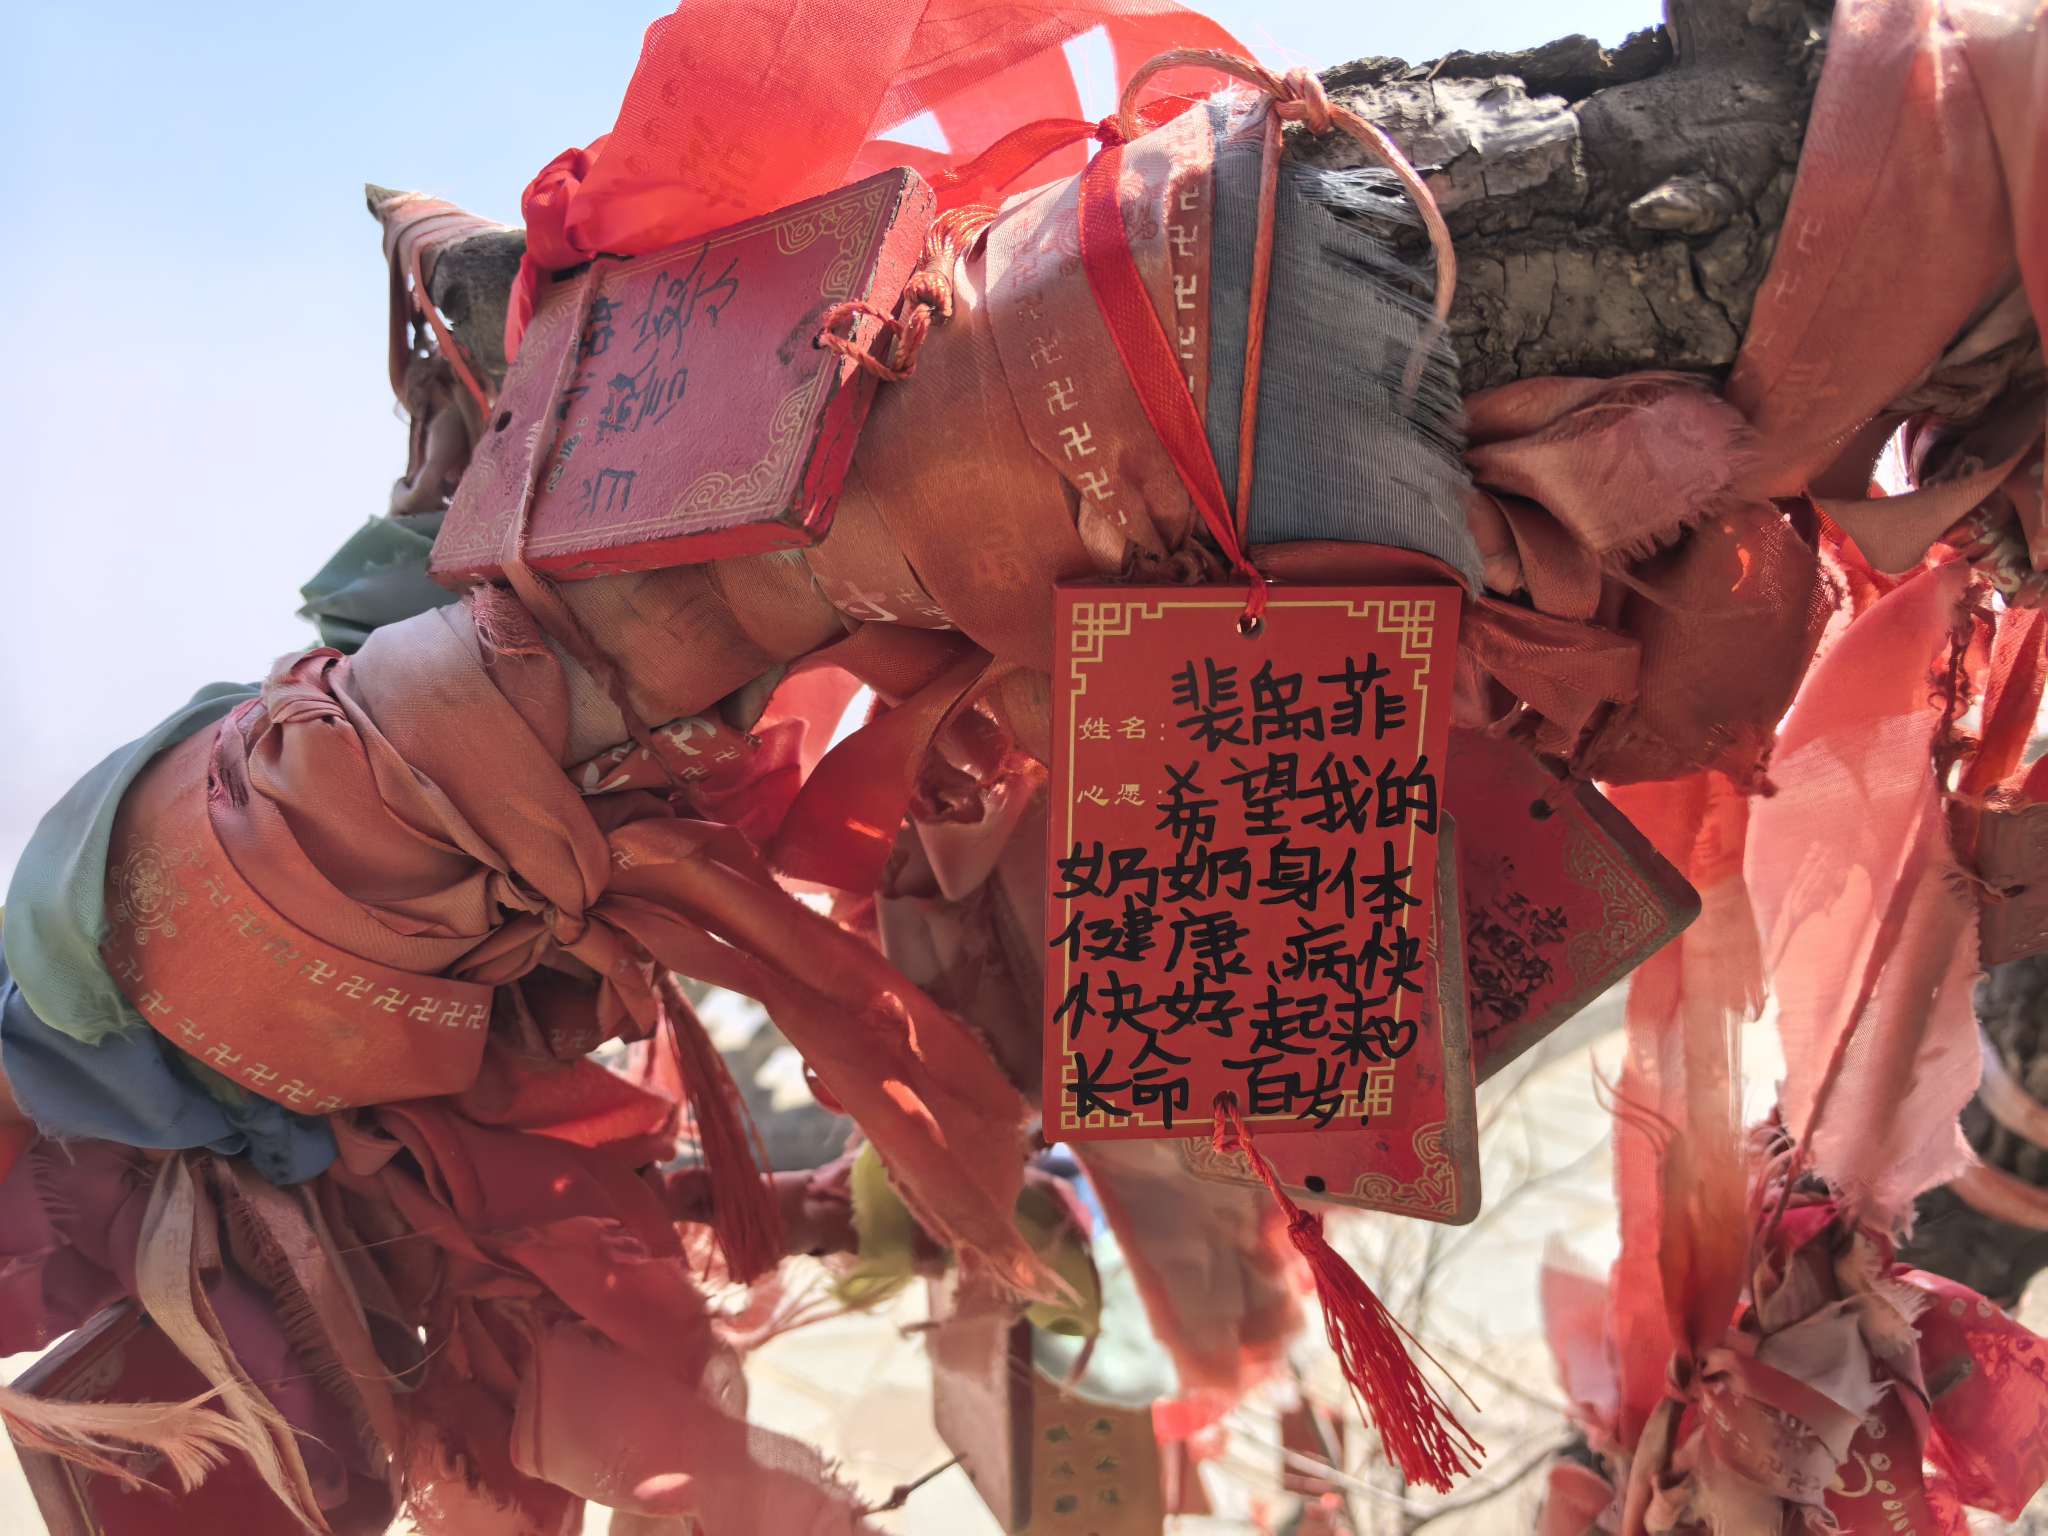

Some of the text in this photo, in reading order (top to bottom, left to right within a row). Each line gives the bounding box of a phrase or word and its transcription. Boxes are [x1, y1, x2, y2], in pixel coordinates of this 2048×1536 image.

[1155, 751, 1438, 853] 希望我的
[1053, 837, 1422, 926] 奶奶身体
[1052, 969, 1390, 1066] 快好起来
